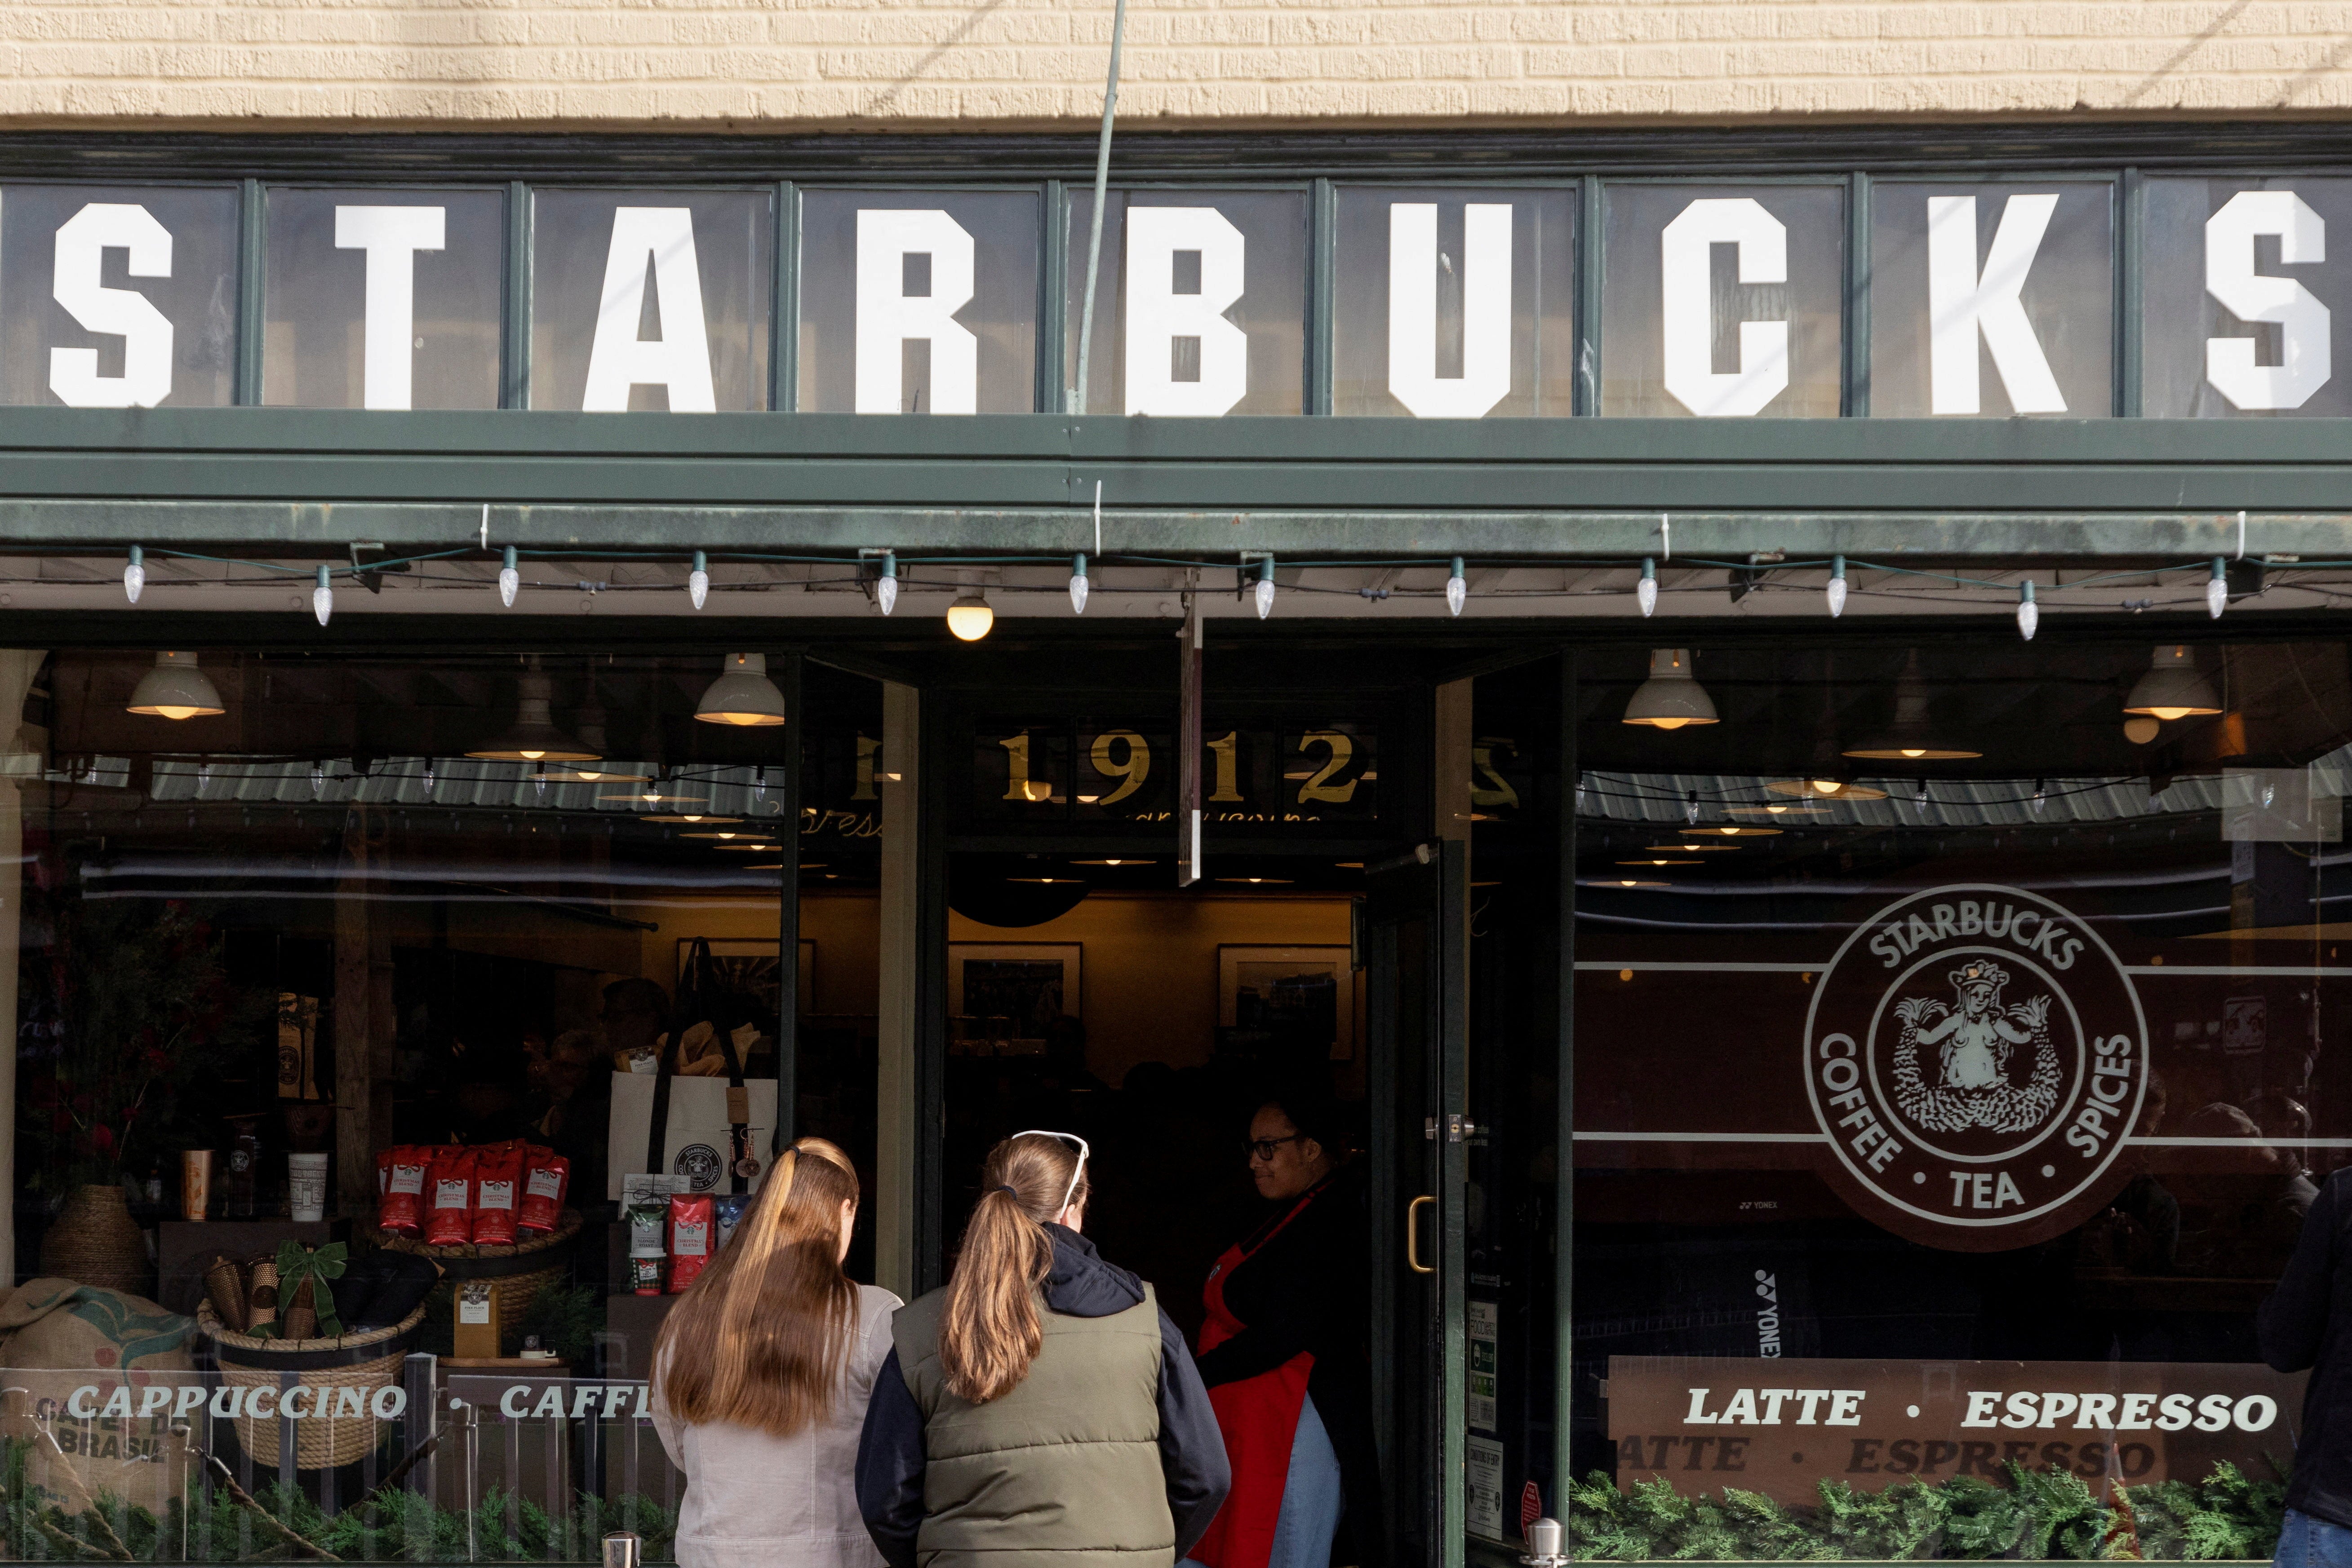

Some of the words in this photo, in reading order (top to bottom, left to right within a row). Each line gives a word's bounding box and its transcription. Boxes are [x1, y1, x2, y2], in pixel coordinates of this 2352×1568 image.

[49, 191, 2332, 420] STARBUCKS
[998, 728, 1358, 806] 1912
[1869, 900, 2085, 970] STARBUCKS
[1819, 1032, 1904, 1174] COFFEE
[2066, 1033, 2132, 1159] SPICES
[685, 1147, 713, 1158] STARBUCKS
[708, 1165, 718, 1182] SPICES
[1949, 1170, 2025, 1209] TEA
[67, 1385, 407, 1418] CAPPUCCINO
[1683, 1388, 1866, 1426] LATTE
[1960, 1391, 2277, 1432] ESPRESSO
